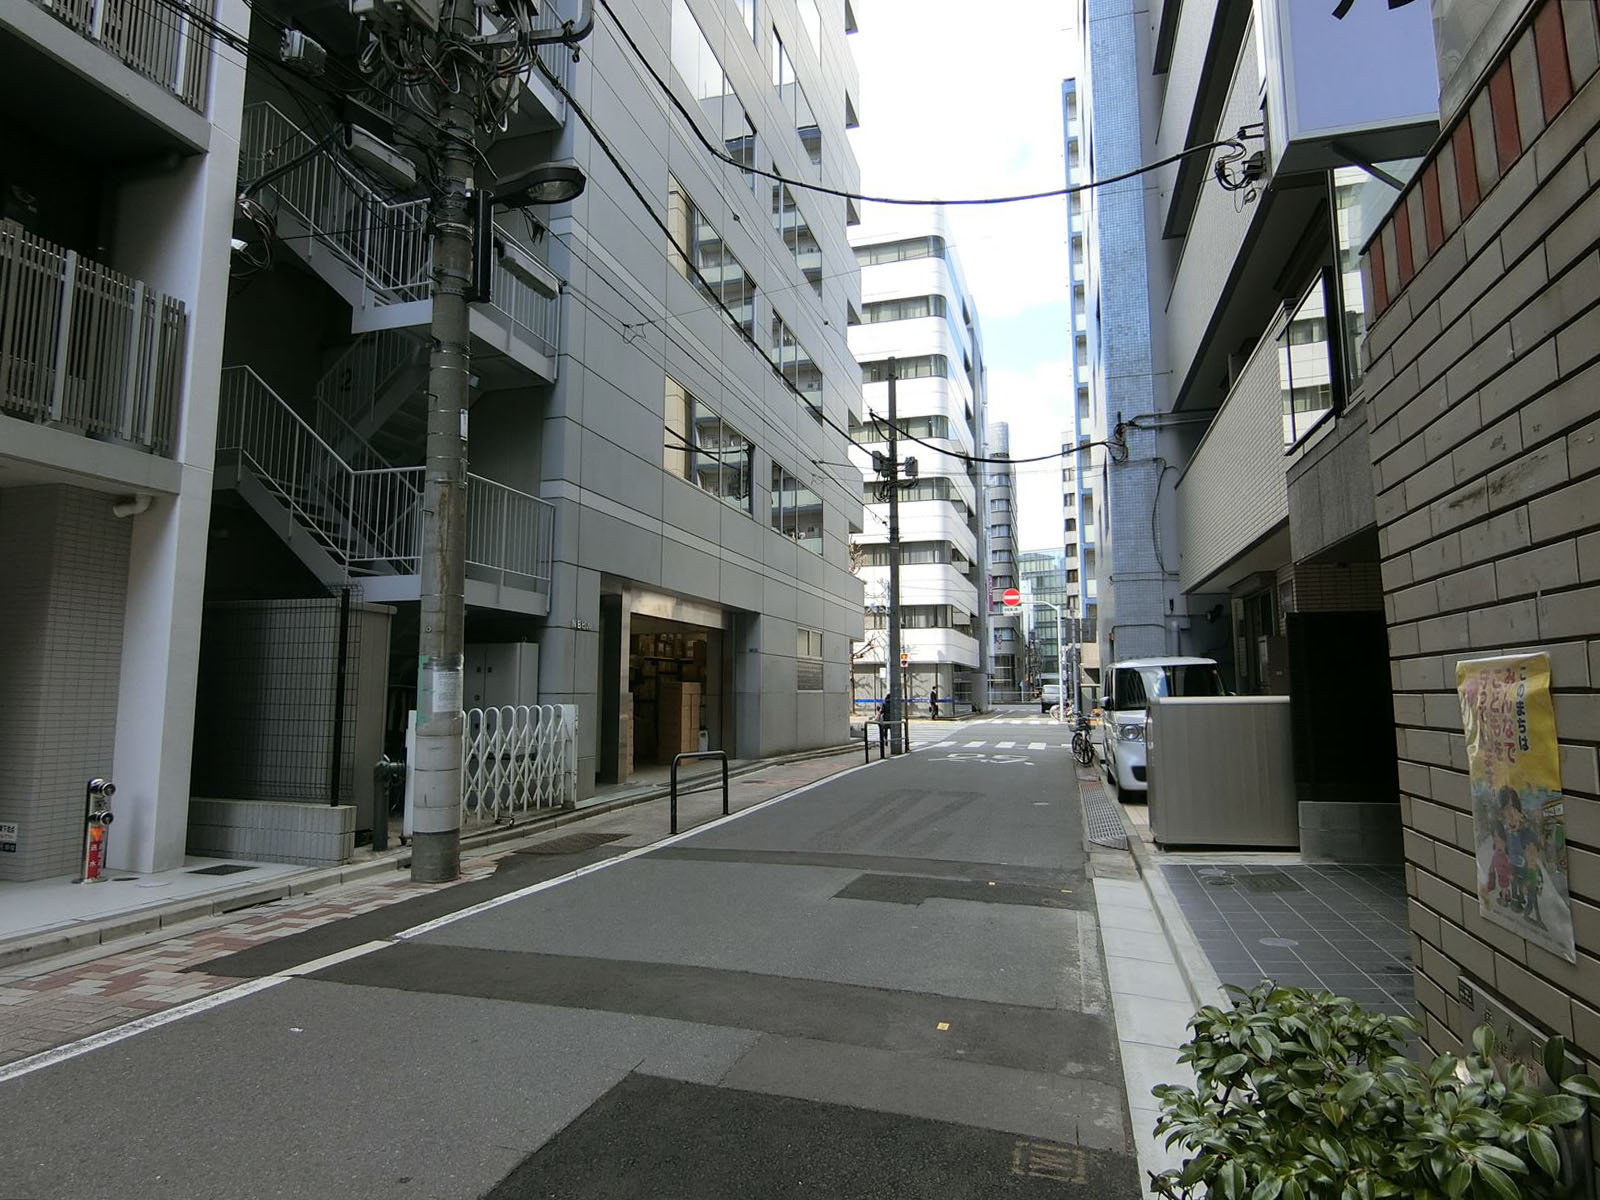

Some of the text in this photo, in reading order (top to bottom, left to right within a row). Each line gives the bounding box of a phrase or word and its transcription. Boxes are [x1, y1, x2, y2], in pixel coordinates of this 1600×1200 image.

[1516, 666, 1530, 752] このまちは
